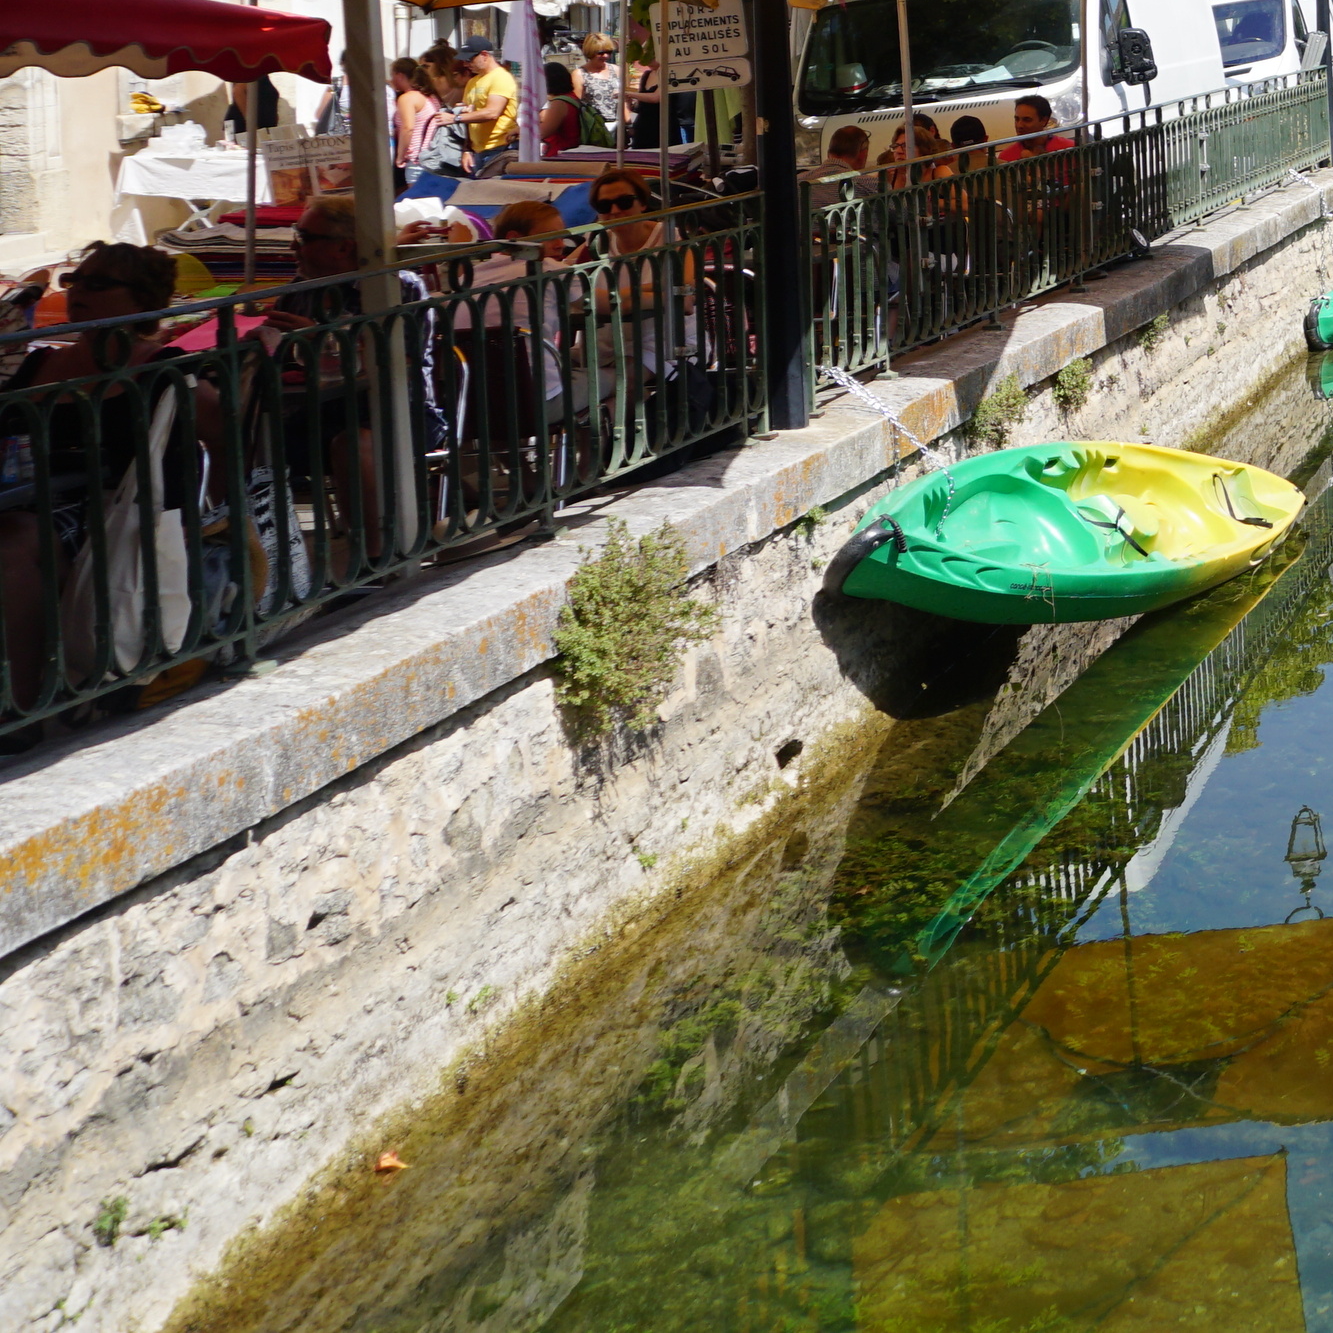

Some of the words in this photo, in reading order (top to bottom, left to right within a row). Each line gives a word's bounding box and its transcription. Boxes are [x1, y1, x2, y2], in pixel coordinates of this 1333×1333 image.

[674, 47, 691, 57] AU
[701, 43, 729, 54] SOL
[266, 143, 294, 154] Tapis
[302, 136, 347, 150] COTON
